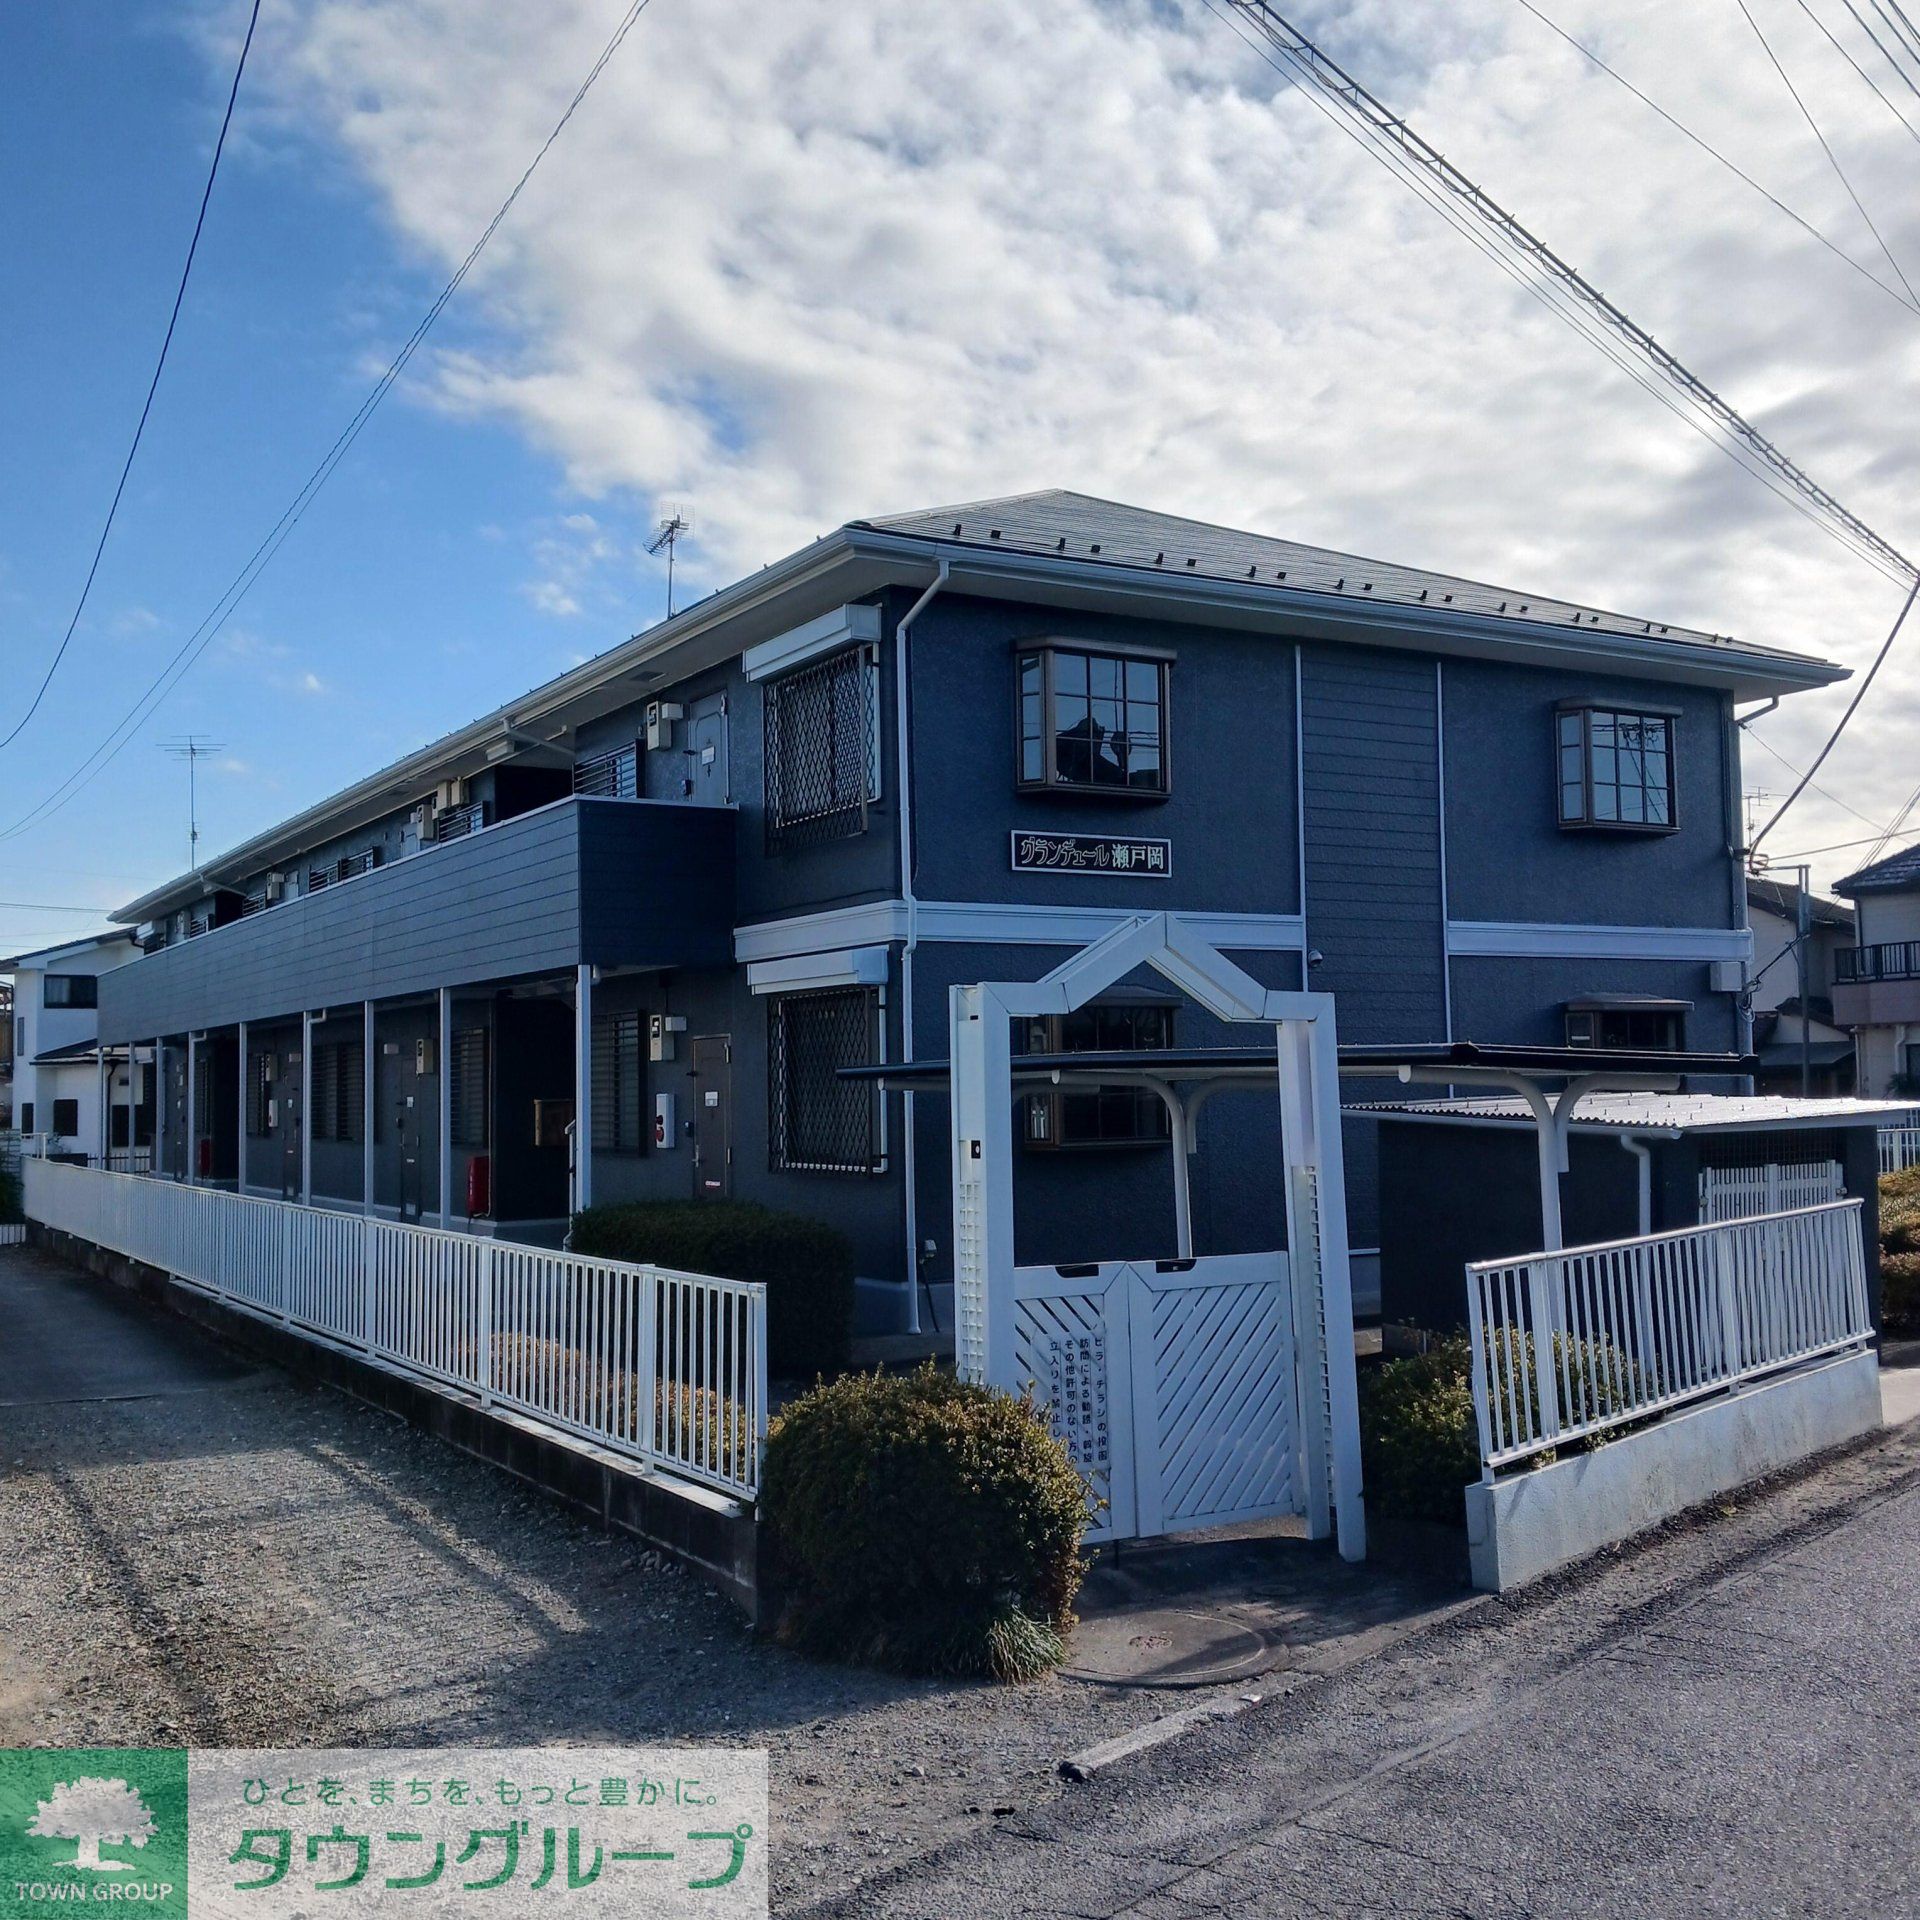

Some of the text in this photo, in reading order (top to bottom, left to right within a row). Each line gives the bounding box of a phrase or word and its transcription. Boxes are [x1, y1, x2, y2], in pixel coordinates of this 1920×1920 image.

[1021, 836, 1164, 870] グランデュール瀬戸岡
